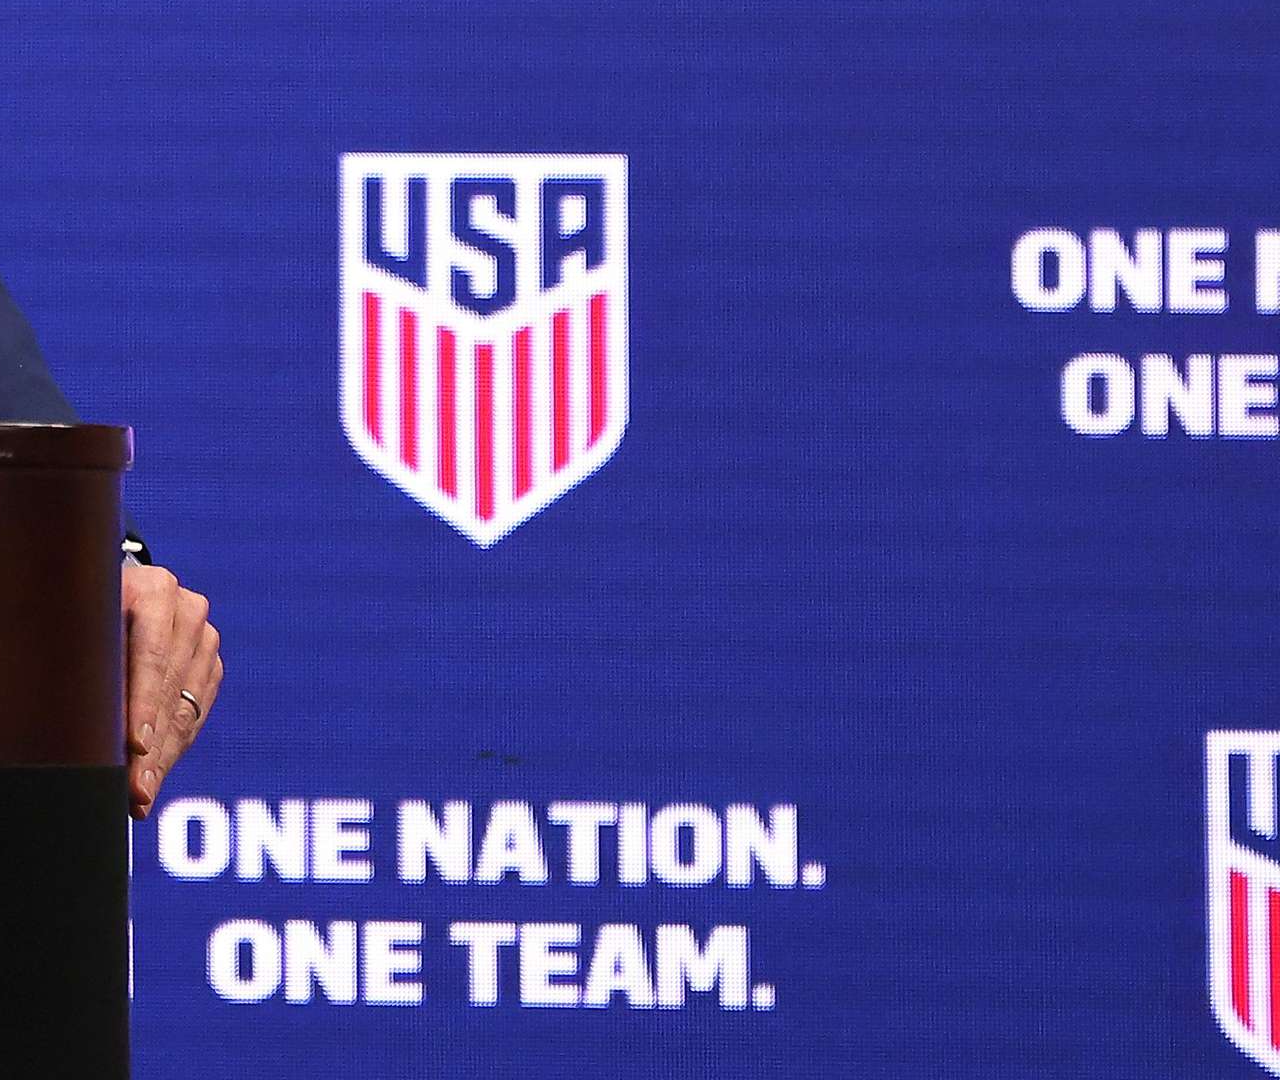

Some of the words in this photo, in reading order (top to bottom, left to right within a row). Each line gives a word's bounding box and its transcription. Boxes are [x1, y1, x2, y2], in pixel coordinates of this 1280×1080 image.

[363, 176, 606, 318] USA
[1010, 227, 1229, 314] ONE
[1060, 353, 1280, 440] ONE
[157, 798, 375, 884] ONE
[397, 800, 825, 889] NATION.
[207, 920, 423, 1007] ONE
[449, 922, 775, 1011] TEAM.
